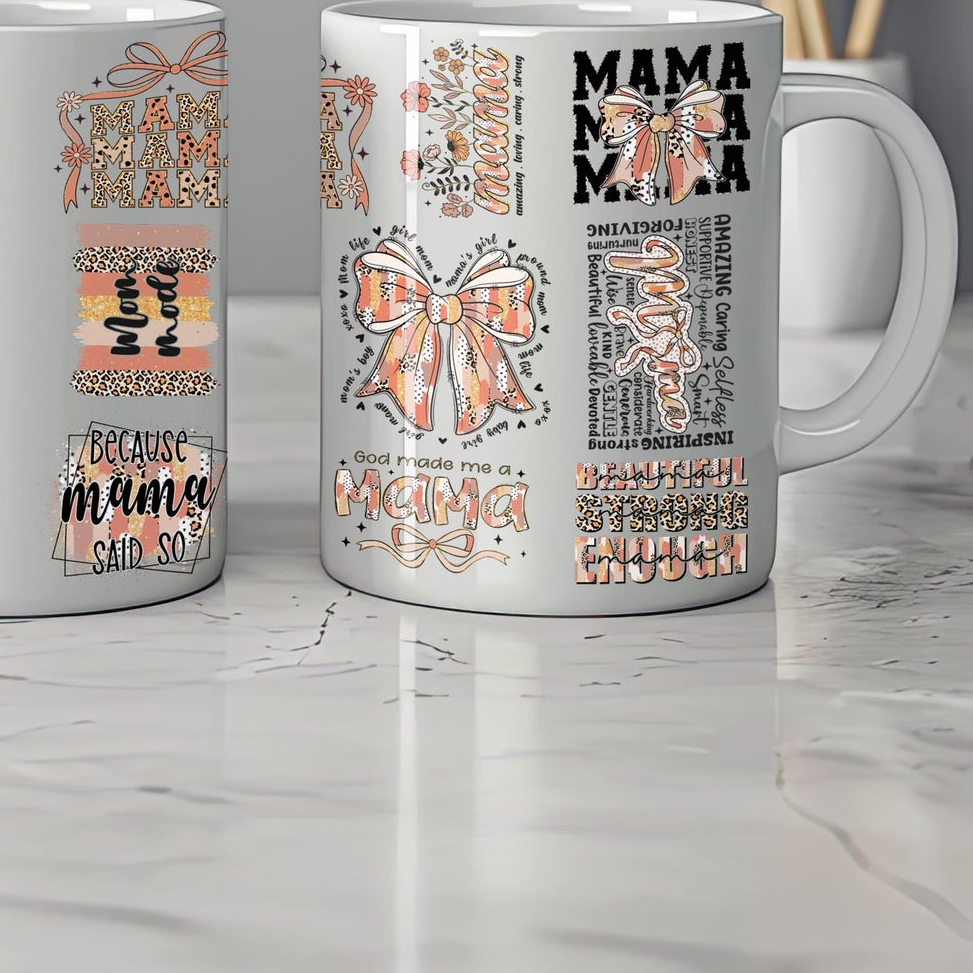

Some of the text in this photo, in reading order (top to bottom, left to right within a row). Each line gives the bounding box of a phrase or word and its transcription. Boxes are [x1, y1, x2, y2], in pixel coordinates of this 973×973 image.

[571, 43, 752, 101] MAMA
[89, 90, 228, 133] MAM
[471, 45, 511, 215] mama
[514, 56, 526, 215] amazing loving caring strong
[89, 129, 228, 171] MAM
[90, 168, 228, 210] MAM
[586, 216, 683, 238] FORGIVING
[713, 213, 732, 297] AMAZING
[103, 256, 151, 356] Mom
[144, 255, 183, 357] mode
[586, 253, 604, 318] Beautiful
[353, 451, 511, 475] God made me a
[640, 429, 734, 453] INSPIRING
[576, 456, 750, 491] BEAUTIFUL
[60, 473, 217, 529] mama
[574, 489, 749, 534] STRONG
[90, 529, 187, 577] SAID SO
[576, 534, 749, 584] ENOUGH
